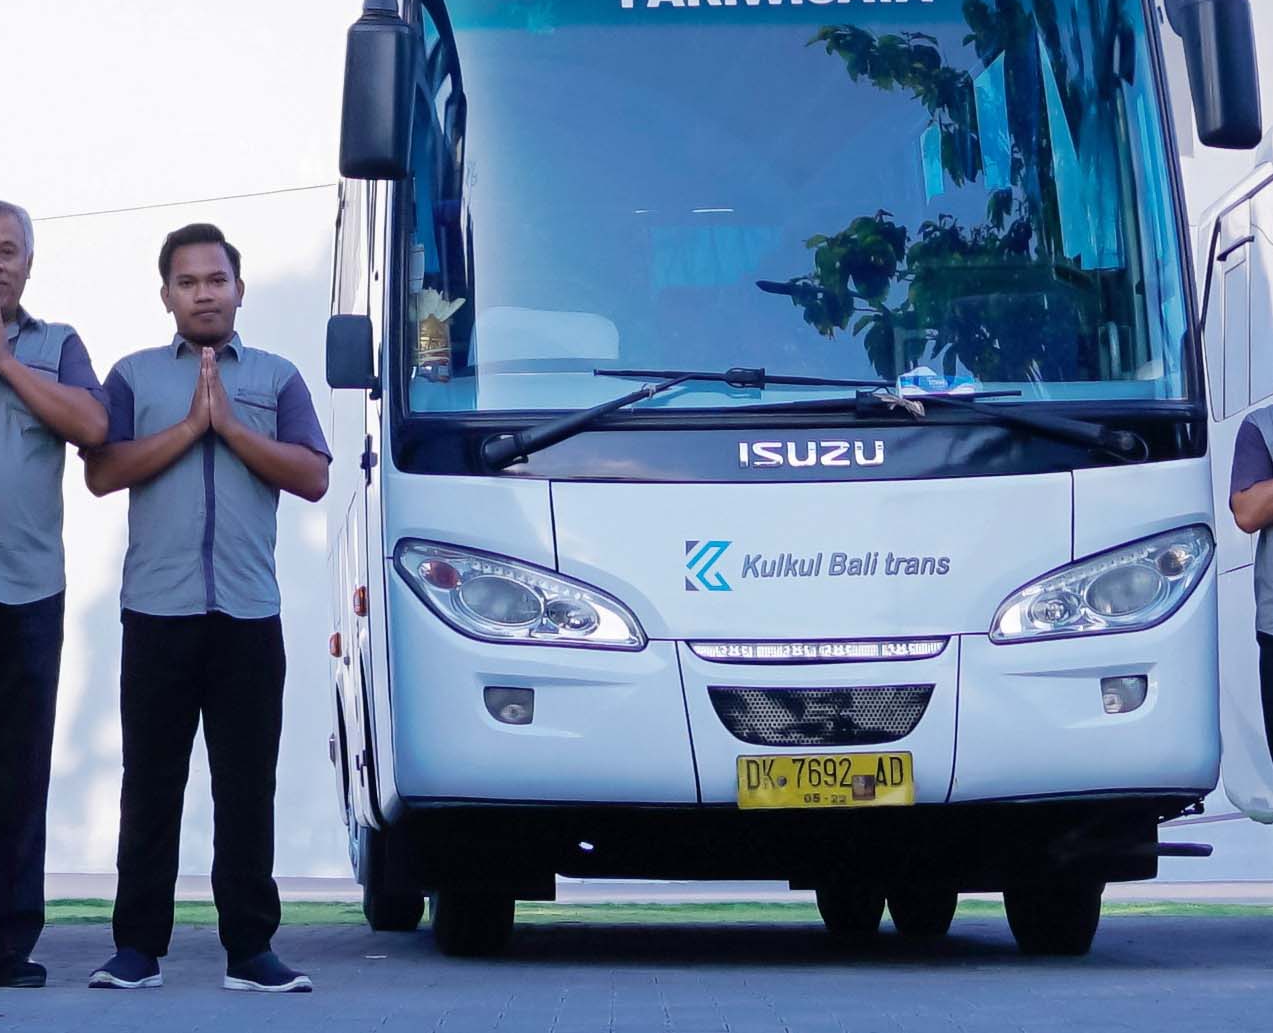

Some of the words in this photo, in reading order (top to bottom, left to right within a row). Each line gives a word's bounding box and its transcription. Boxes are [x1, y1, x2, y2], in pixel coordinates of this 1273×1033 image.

[737, 440, 885, 469] ISUZU
[741, 552, 823, 579] Kulkul
[827, 551, 878, 577] Bali
[884, 551, 951, 576] trans
[746, 757, 776, 790] DK
[791, 757, 852, 789] 7692
[875, 756, 905, 786] AD
